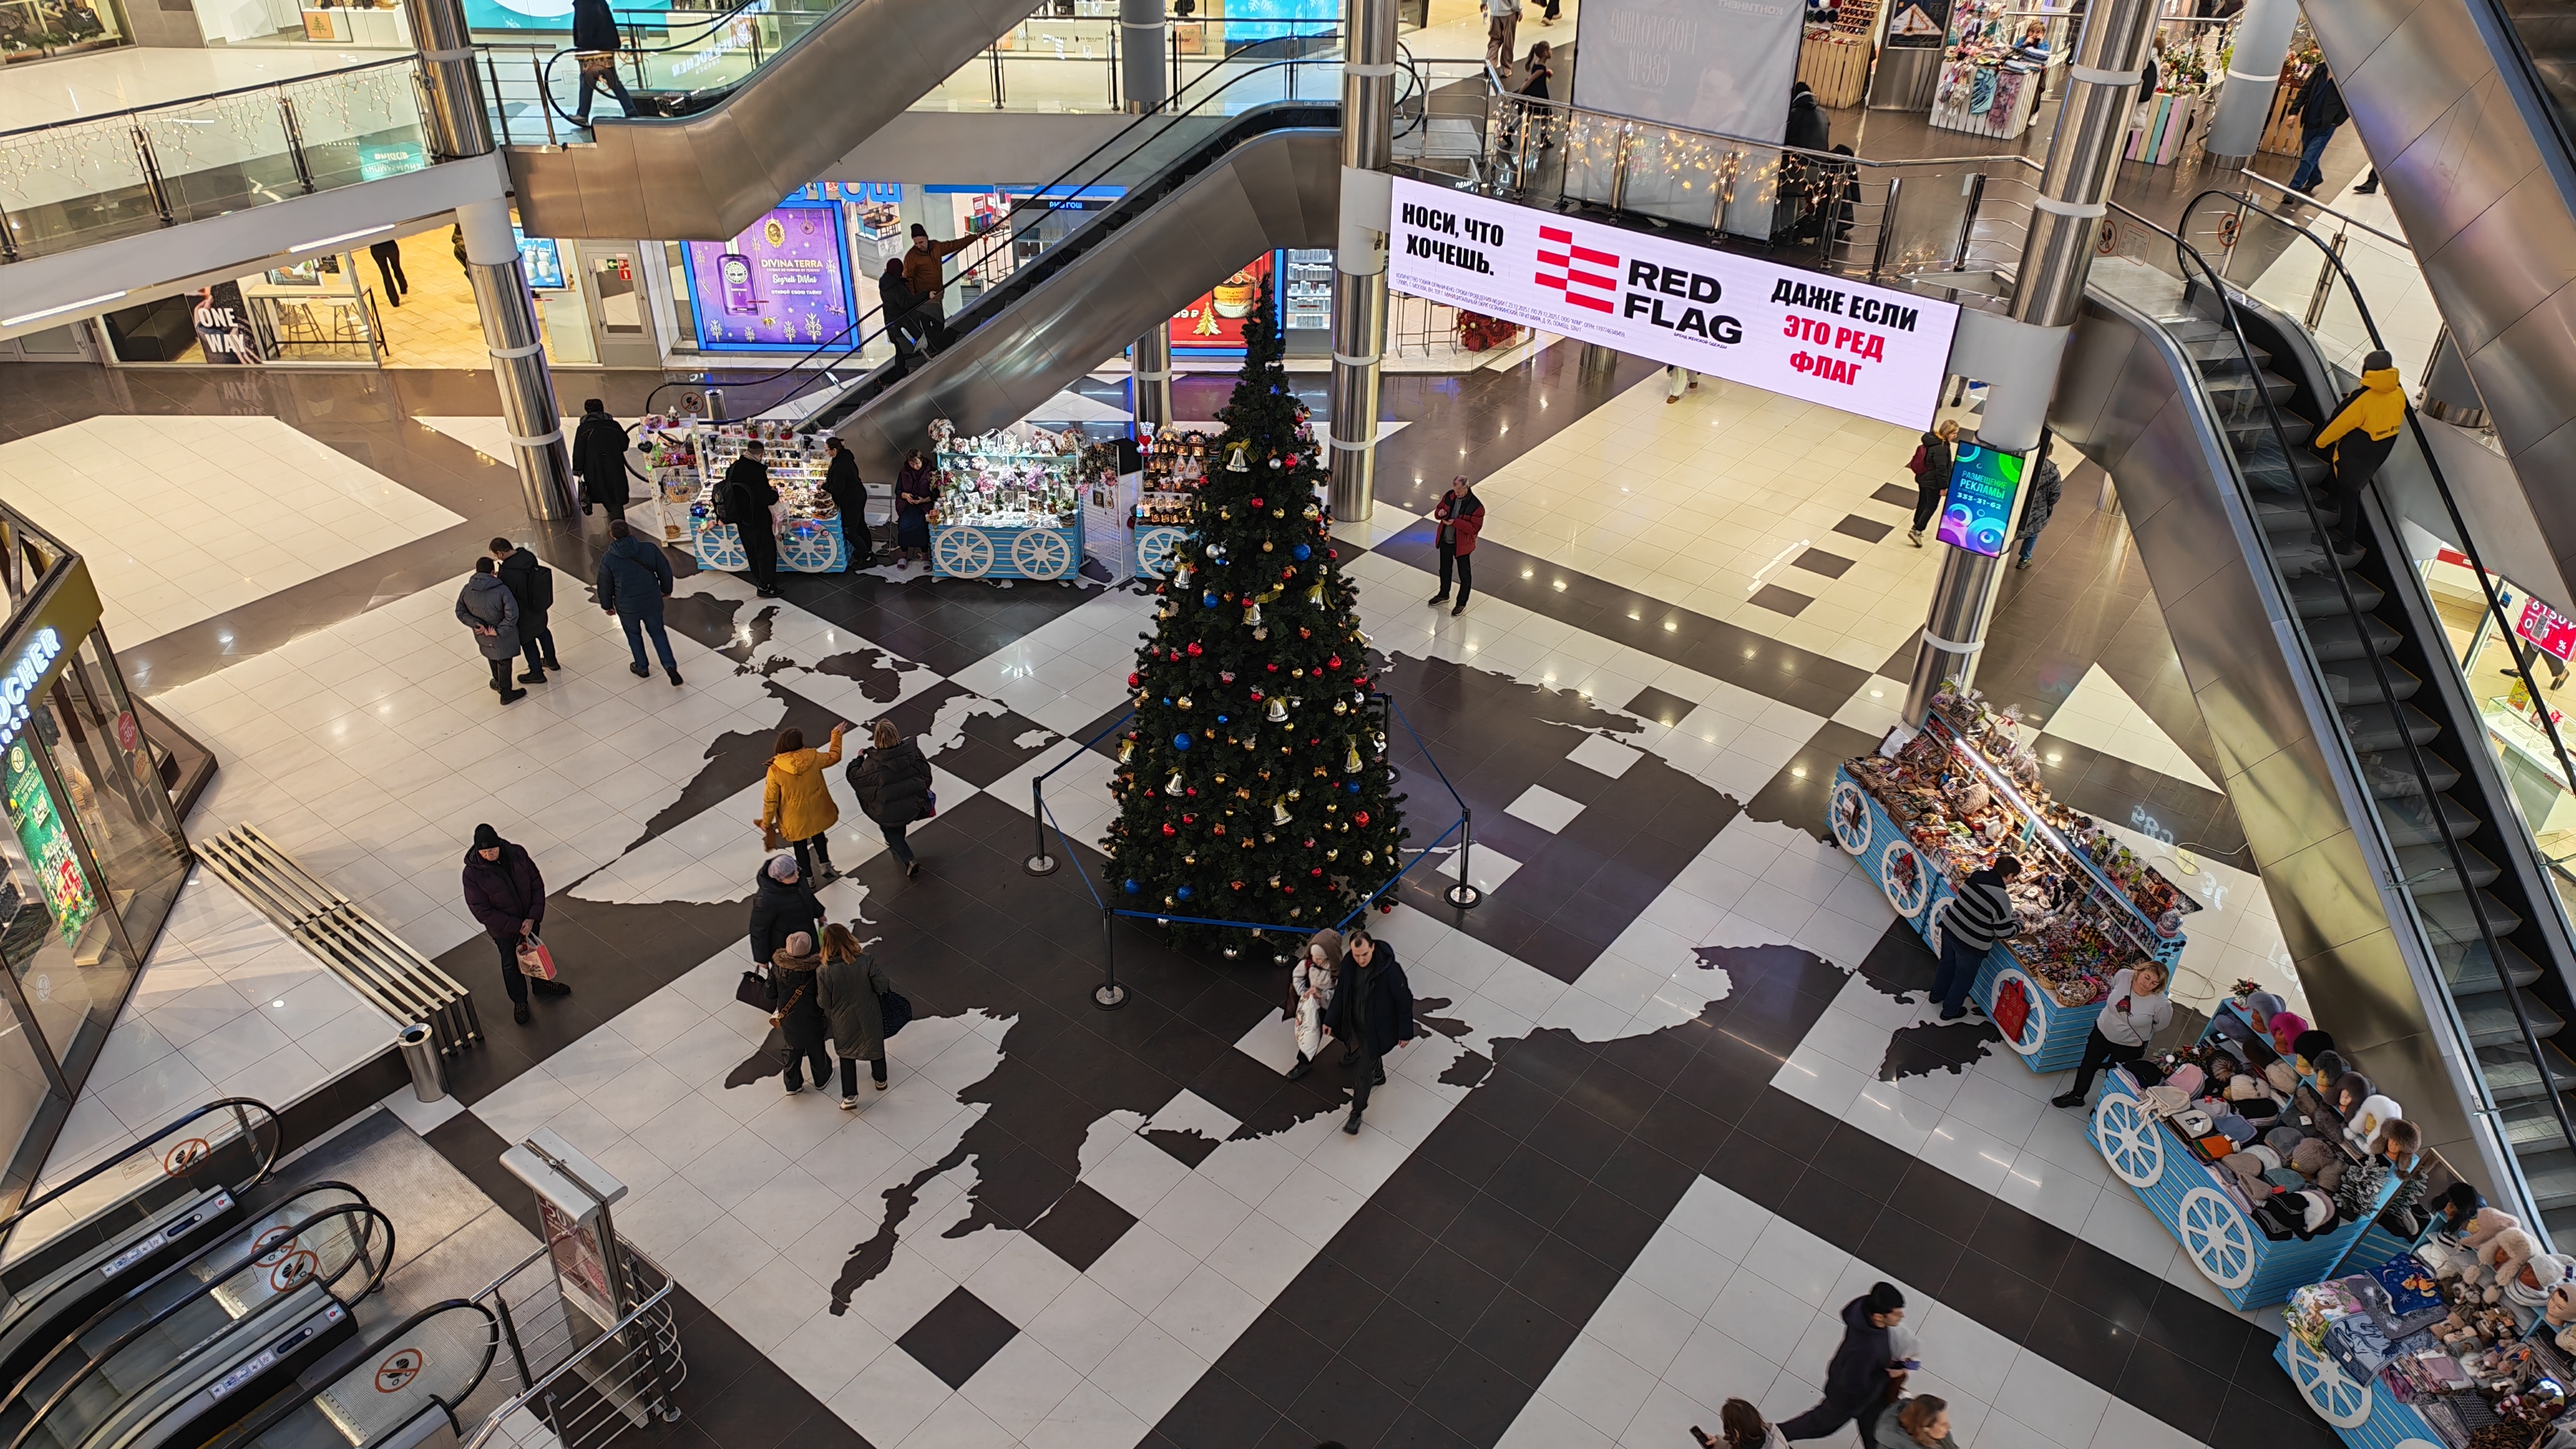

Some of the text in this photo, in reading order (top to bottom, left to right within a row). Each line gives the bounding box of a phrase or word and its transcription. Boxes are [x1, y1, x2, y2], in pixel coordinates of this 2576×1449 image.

[1402, 203, 1504, 247] НОСИ, ЧТО
[762, 258, 823, 268] DIVINA TERRA
[1406, 233, 1494, 276] ХОЧЕШЬ.
[1628, 258, 1722, 304] RED
[197, 308, 238, 328] ONE
[1624, 292, 1743, 345] FLAG
[1770, 278, 1919, 332] ДАЖЕ ЕСЛИ
[204, 333, 246, 353] WAY
[1784, 314, 1885, 364] ЭТО РЕД
[1790, 350, 1862, 386] ФЛАГ
[1960, 478, 2006, 499] РЕКЛАМЫ
[1962, 470, 2007, 489] РАЗМЕЩЕНИЕ
[1957, 492, 2002, 510] 333-31-62
